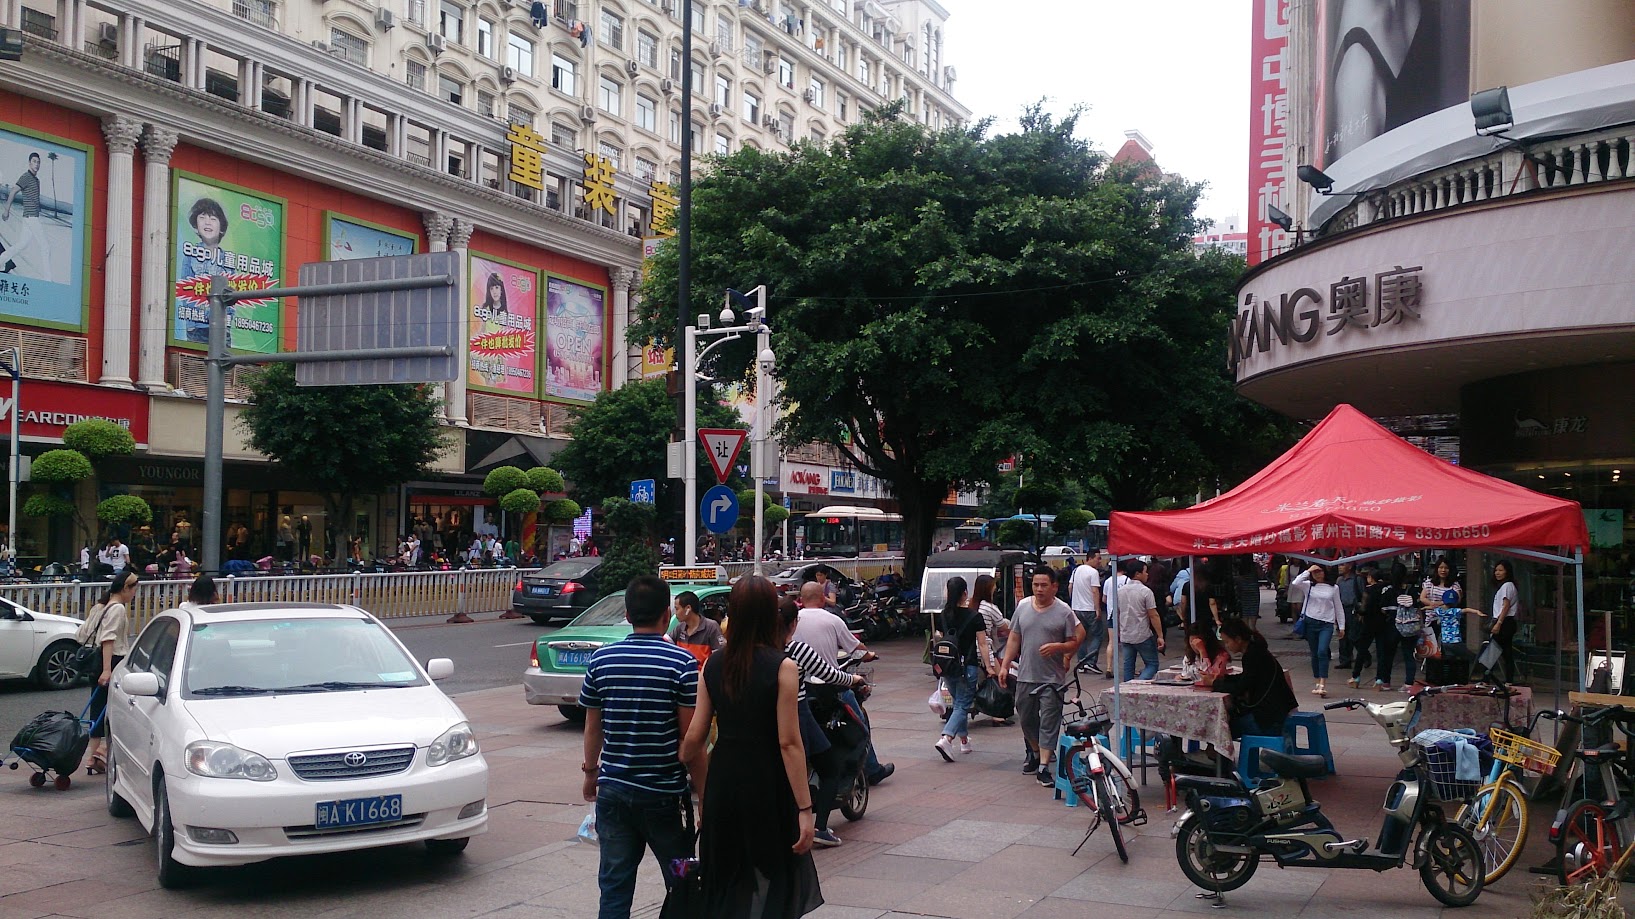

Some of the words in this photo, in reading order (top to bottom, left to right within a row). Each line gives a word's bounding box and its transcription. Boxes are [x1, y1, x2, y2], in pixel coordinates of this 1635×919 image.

[1326, 265, 1424, 337] 奥康
[234, 317, 274, 333] 18950467236
[556, 332, 593, 354] OPEN
[716, 440, 729, 459] 让
[139, 465, 200, 480] YOUNGOR
[1311, 523, 1407, 540] 福州古田路7号
[1415, 525, 1490, 540] 83376650
